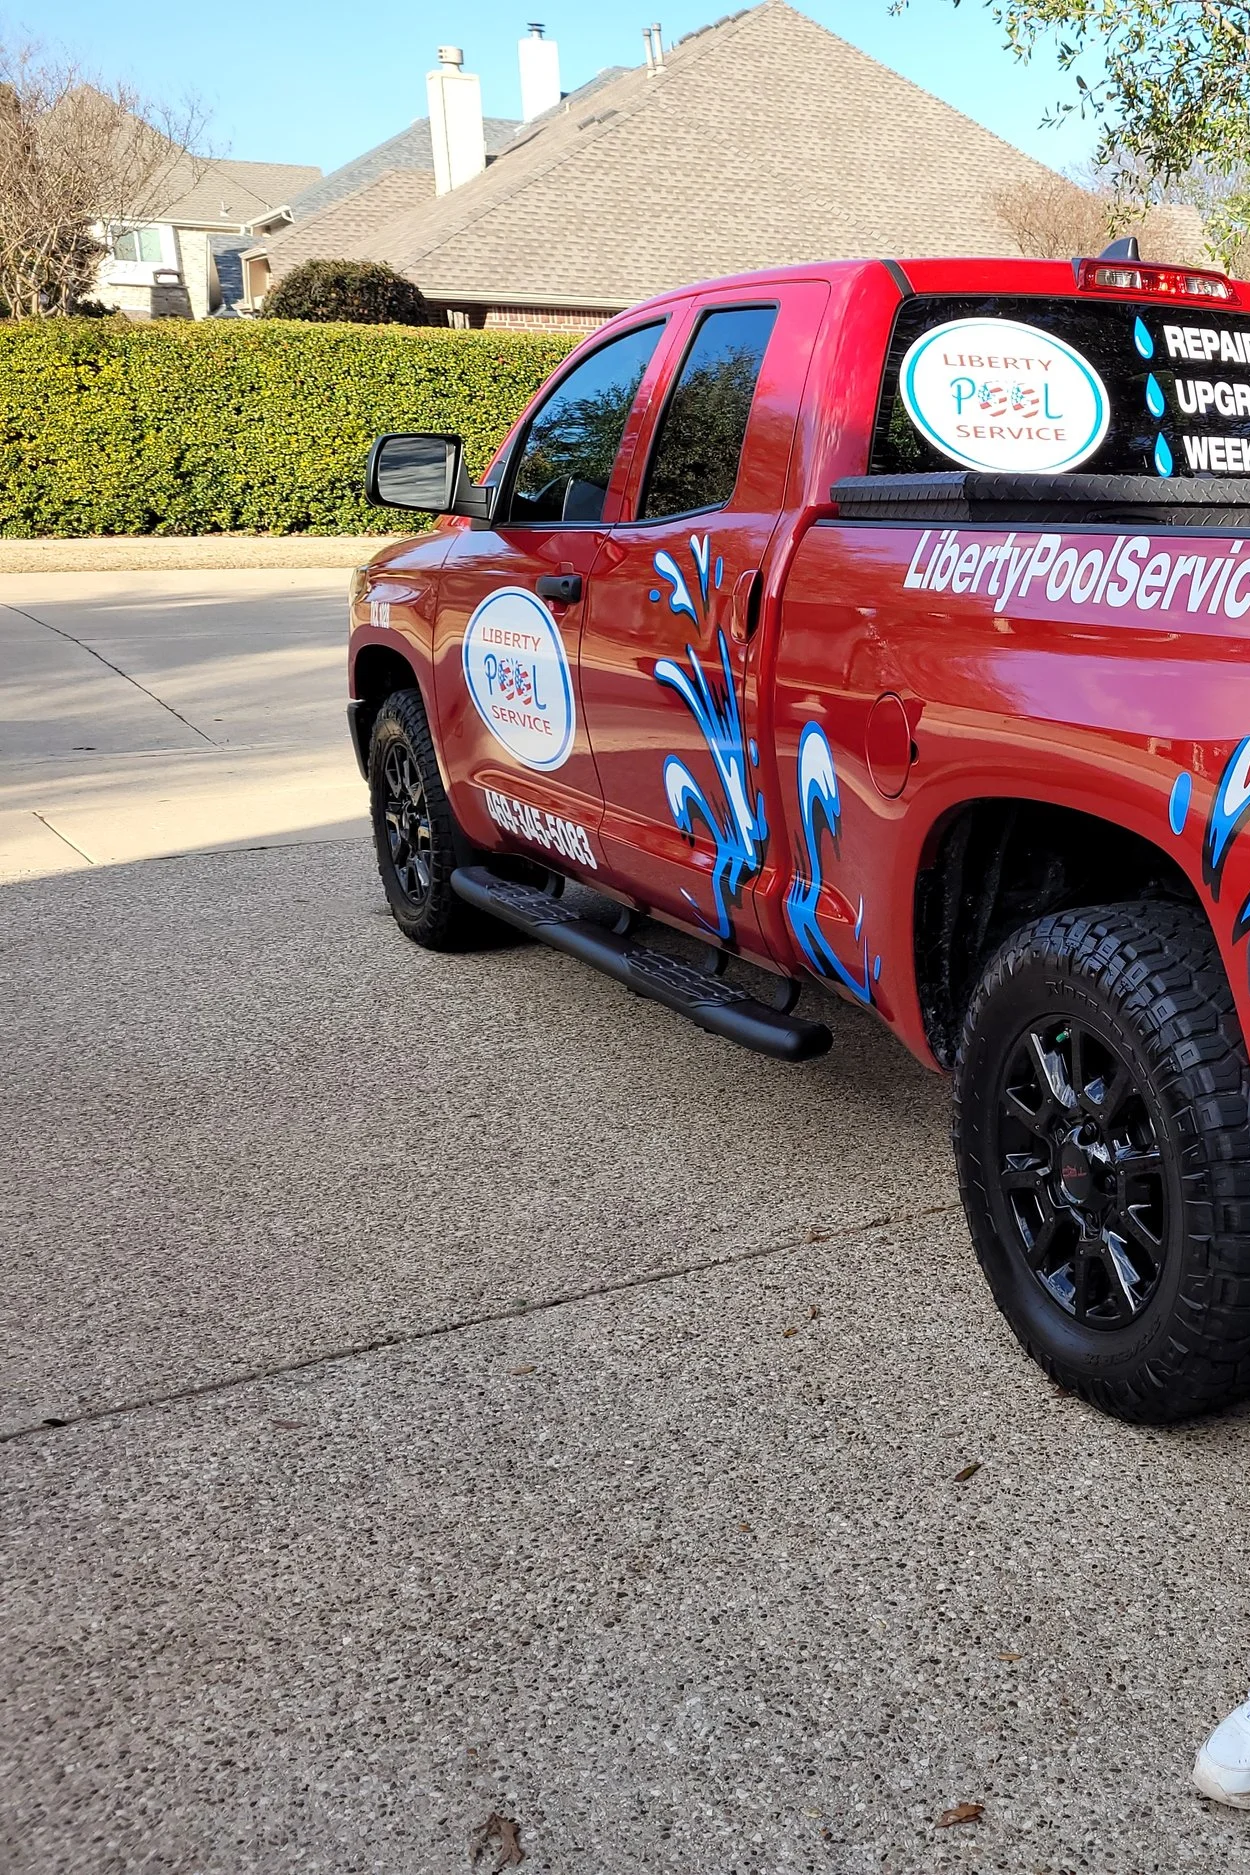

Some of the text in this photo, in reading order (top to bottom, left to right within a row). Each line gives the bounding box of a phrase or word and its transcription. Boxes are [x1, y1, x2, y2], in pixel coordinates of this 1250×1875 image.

[943, 353, 1052, 371] LIBERTY
[950, 377, 1063, 419] POOL
[956, 424, 1067, 441] SERVICE
[482, 627, 541, 652] LIBERTY
[491, 704, 553, 735] SERVICE
[484, 789, 598, 871] 469-345-5083
